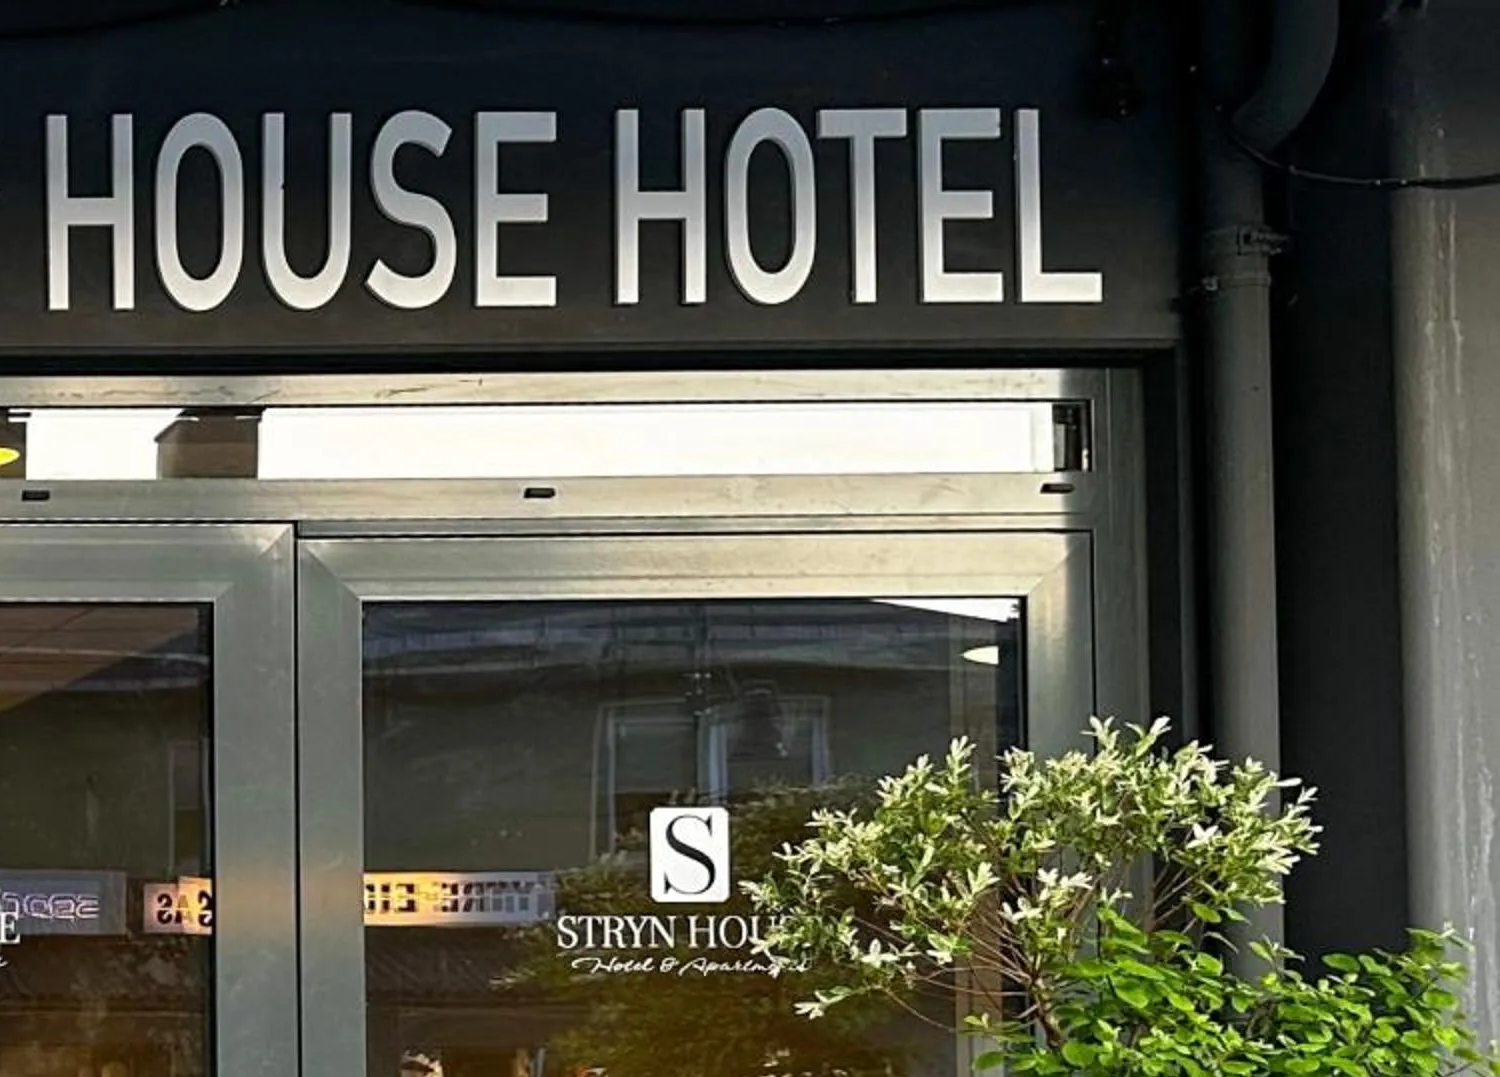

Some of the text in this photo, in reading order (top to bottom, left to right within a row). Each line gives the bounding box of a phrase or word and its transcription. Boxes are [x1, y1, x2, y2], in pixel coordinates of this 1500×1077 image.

[46, 110, 557, 312] HOUSE
[615, 107, 1103, 306] HOTEL
[663, 815, 716, 895] S
[557, 915, 821, 949] STRYN HOU
[571, 956, 655, 974] Hotel
[659, 957, 679, 973] &
